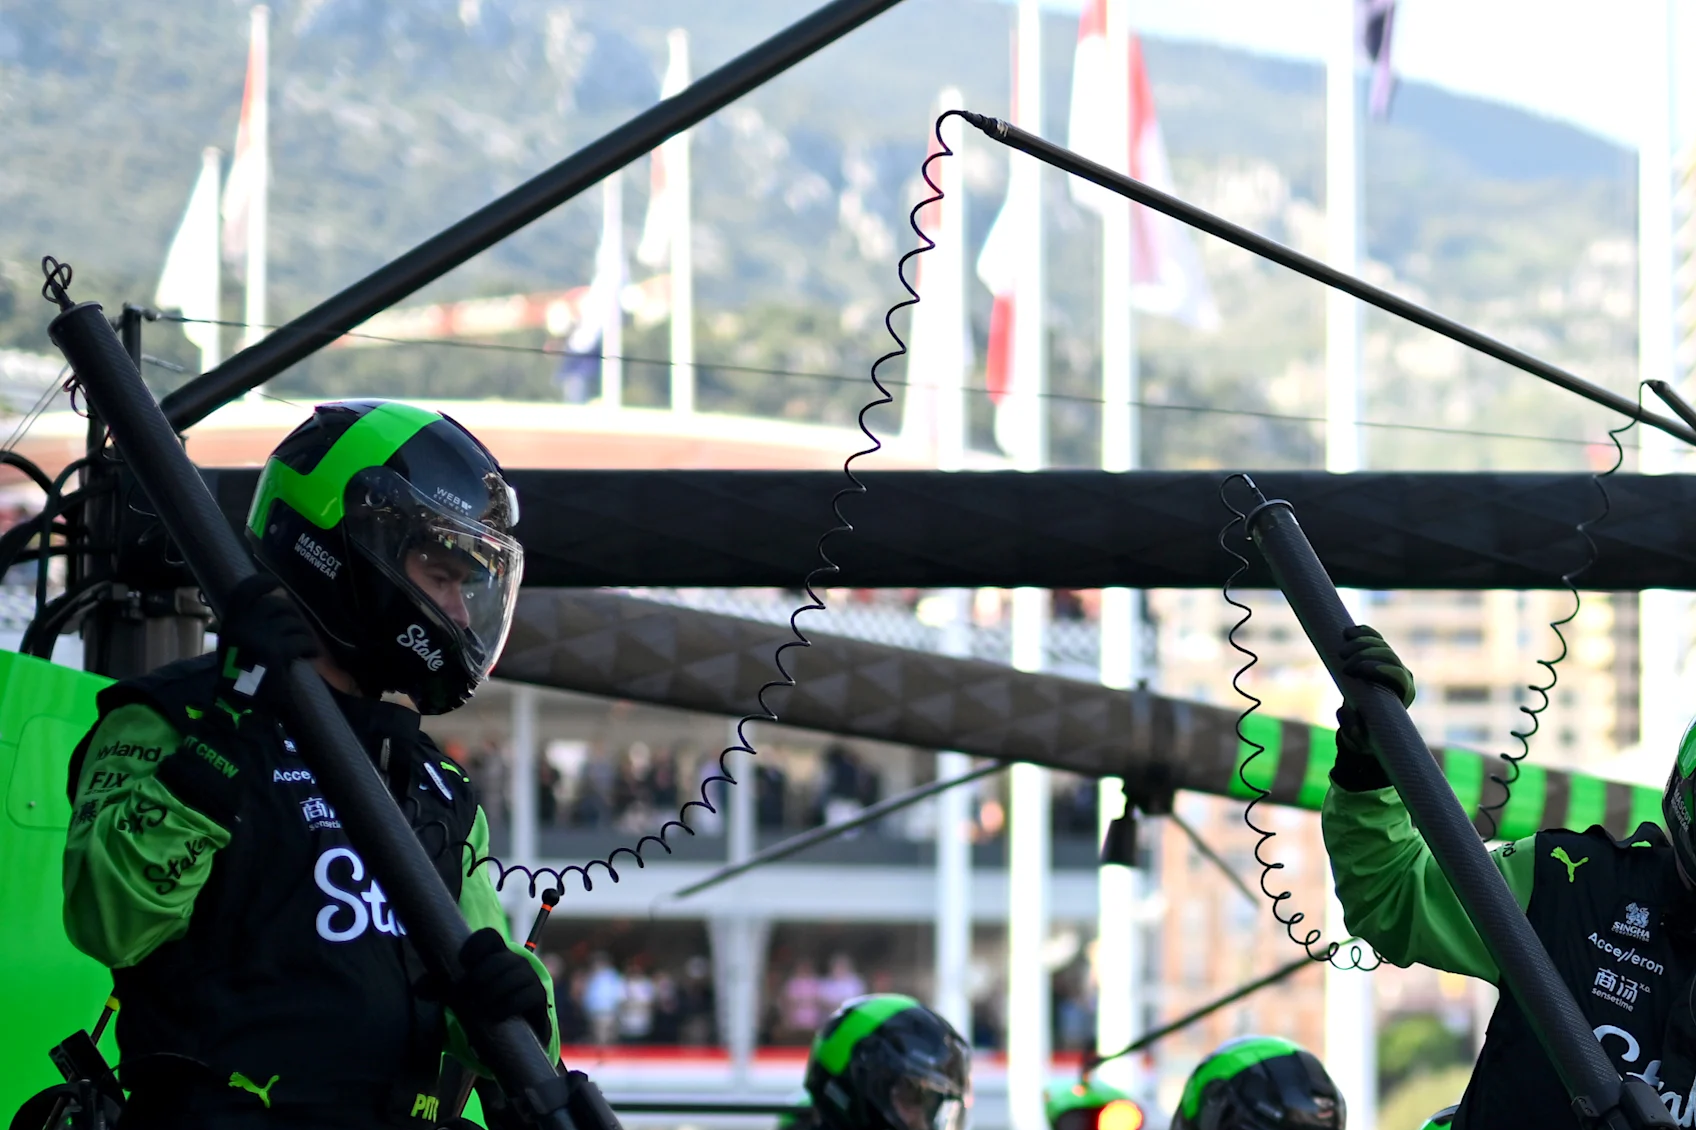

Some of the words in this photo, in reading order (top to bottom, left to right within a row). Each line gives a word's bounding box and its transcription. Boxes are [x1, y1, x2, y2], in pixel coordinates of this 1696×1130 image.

[436, 486, 460, 504] WEB
[294, 542, 337, 580] WORKWEAR
[298, 533, 342, 571] MASCOT
[396, 624, 444, 671] Stake
[195, 743, 239, 779] CREW
[89, 771, 131, 789] FIX
[1674, 787, 1692, 825] MASCOT
[1613, 921, 1651, 939] SINGHA
[1591, 987, 1634, 1013] sensetime
[1593, 967, 1640, 1004] 商汤
